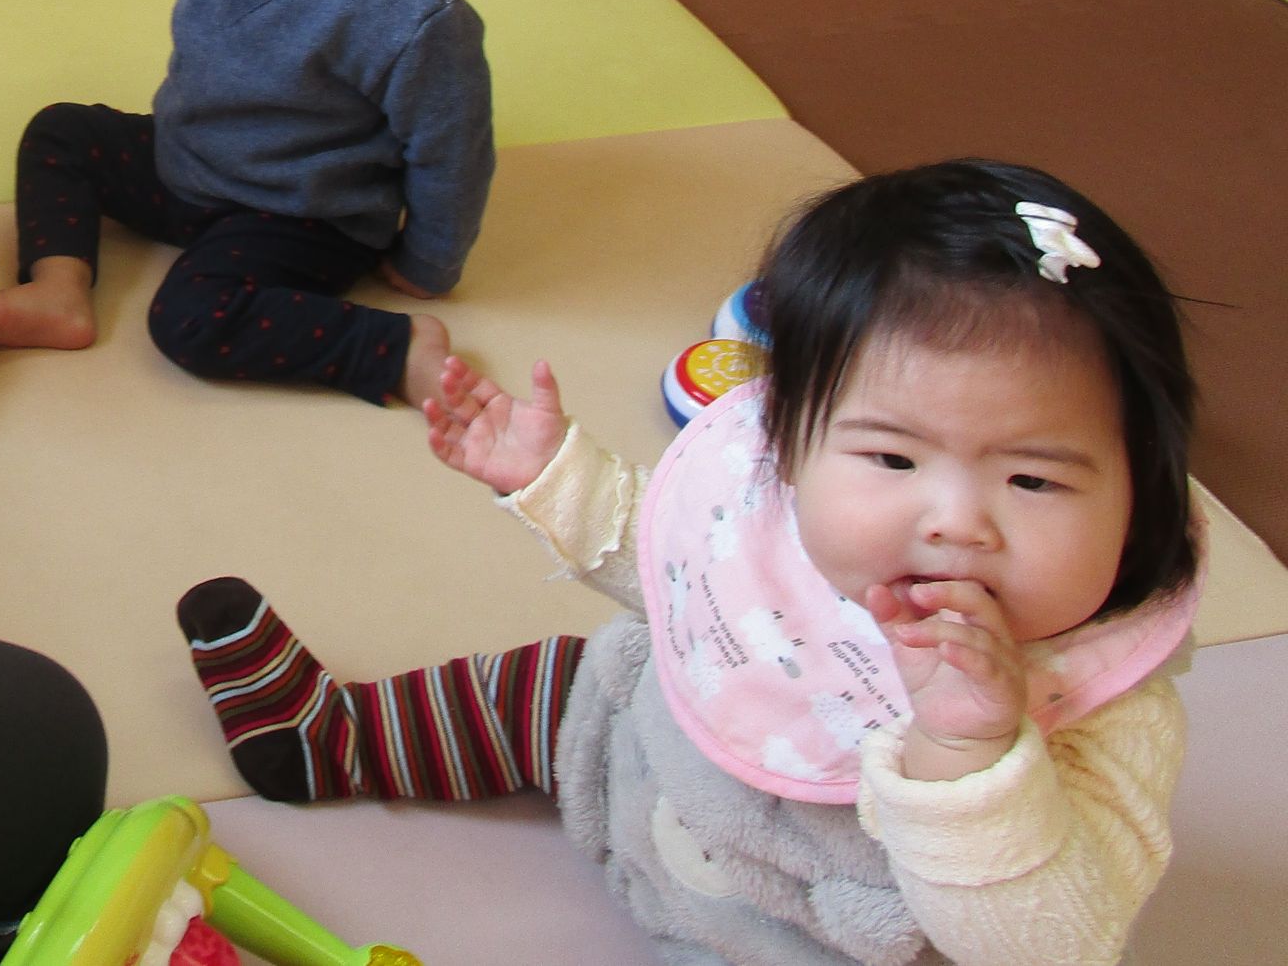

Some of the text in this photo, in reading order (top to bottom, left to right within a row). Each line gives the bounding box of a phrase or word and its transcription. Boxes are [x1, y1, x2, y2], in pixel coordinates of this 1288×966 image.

[827, 640, 863, 678] breeding
[865, 663, 879, 676] of
[859, 676, 878, 696] the
